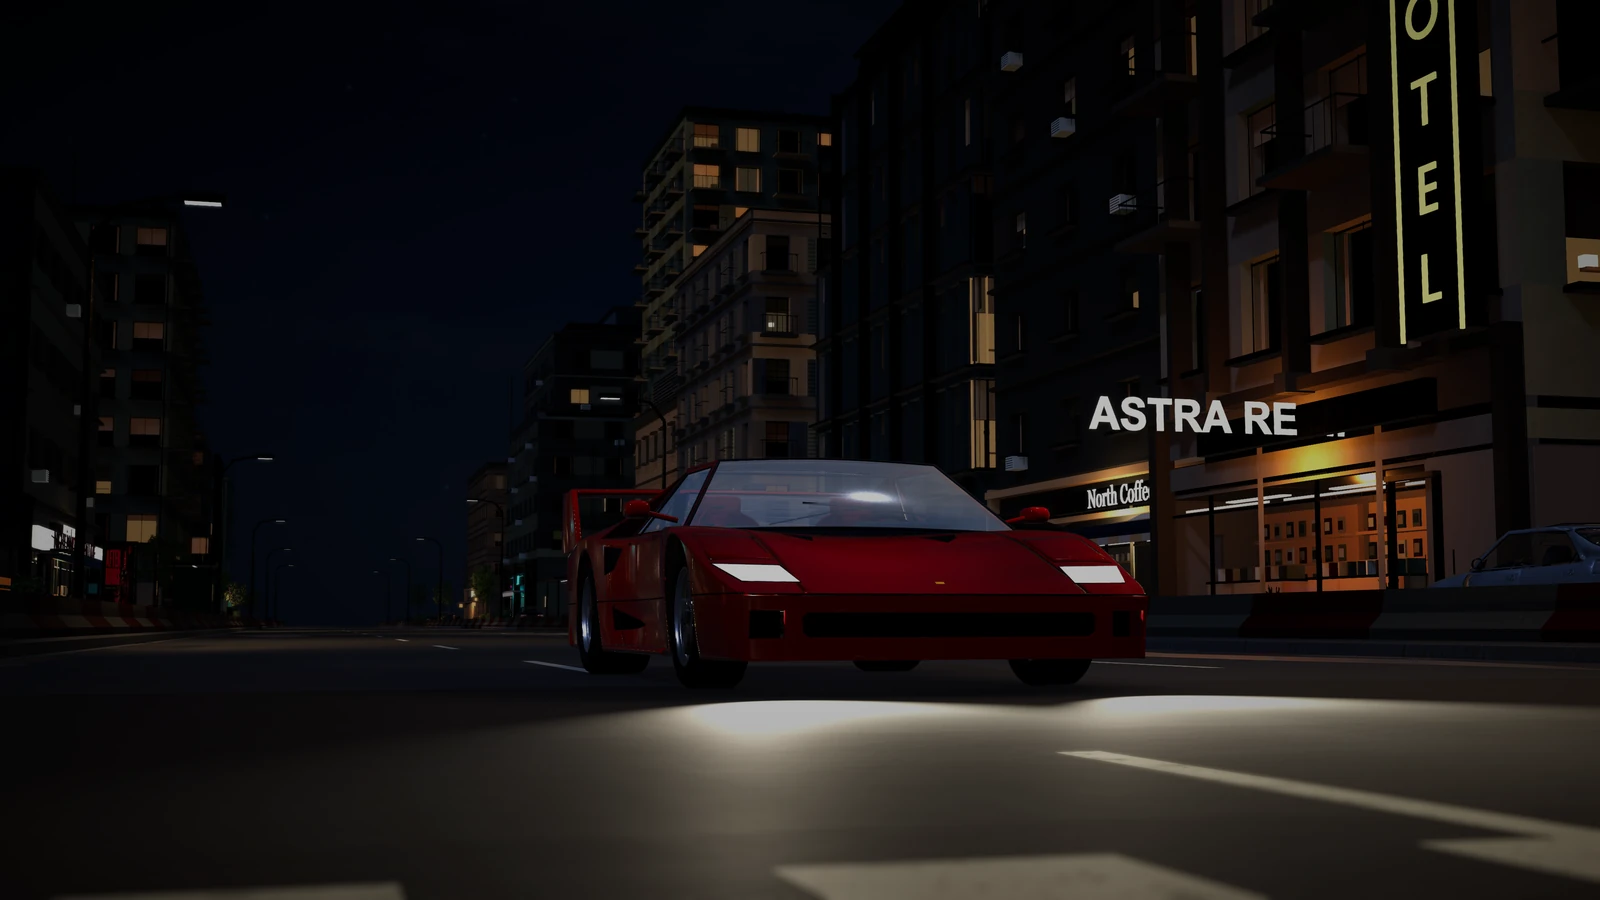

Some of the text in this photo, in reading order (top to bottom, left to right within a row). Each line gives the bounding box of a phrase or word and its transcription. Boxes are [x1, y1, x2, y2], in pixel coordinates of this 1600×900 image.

[1089, 396, 1232, 434] ASTRA
[1087, 479, 1150, 509] North Coffe
